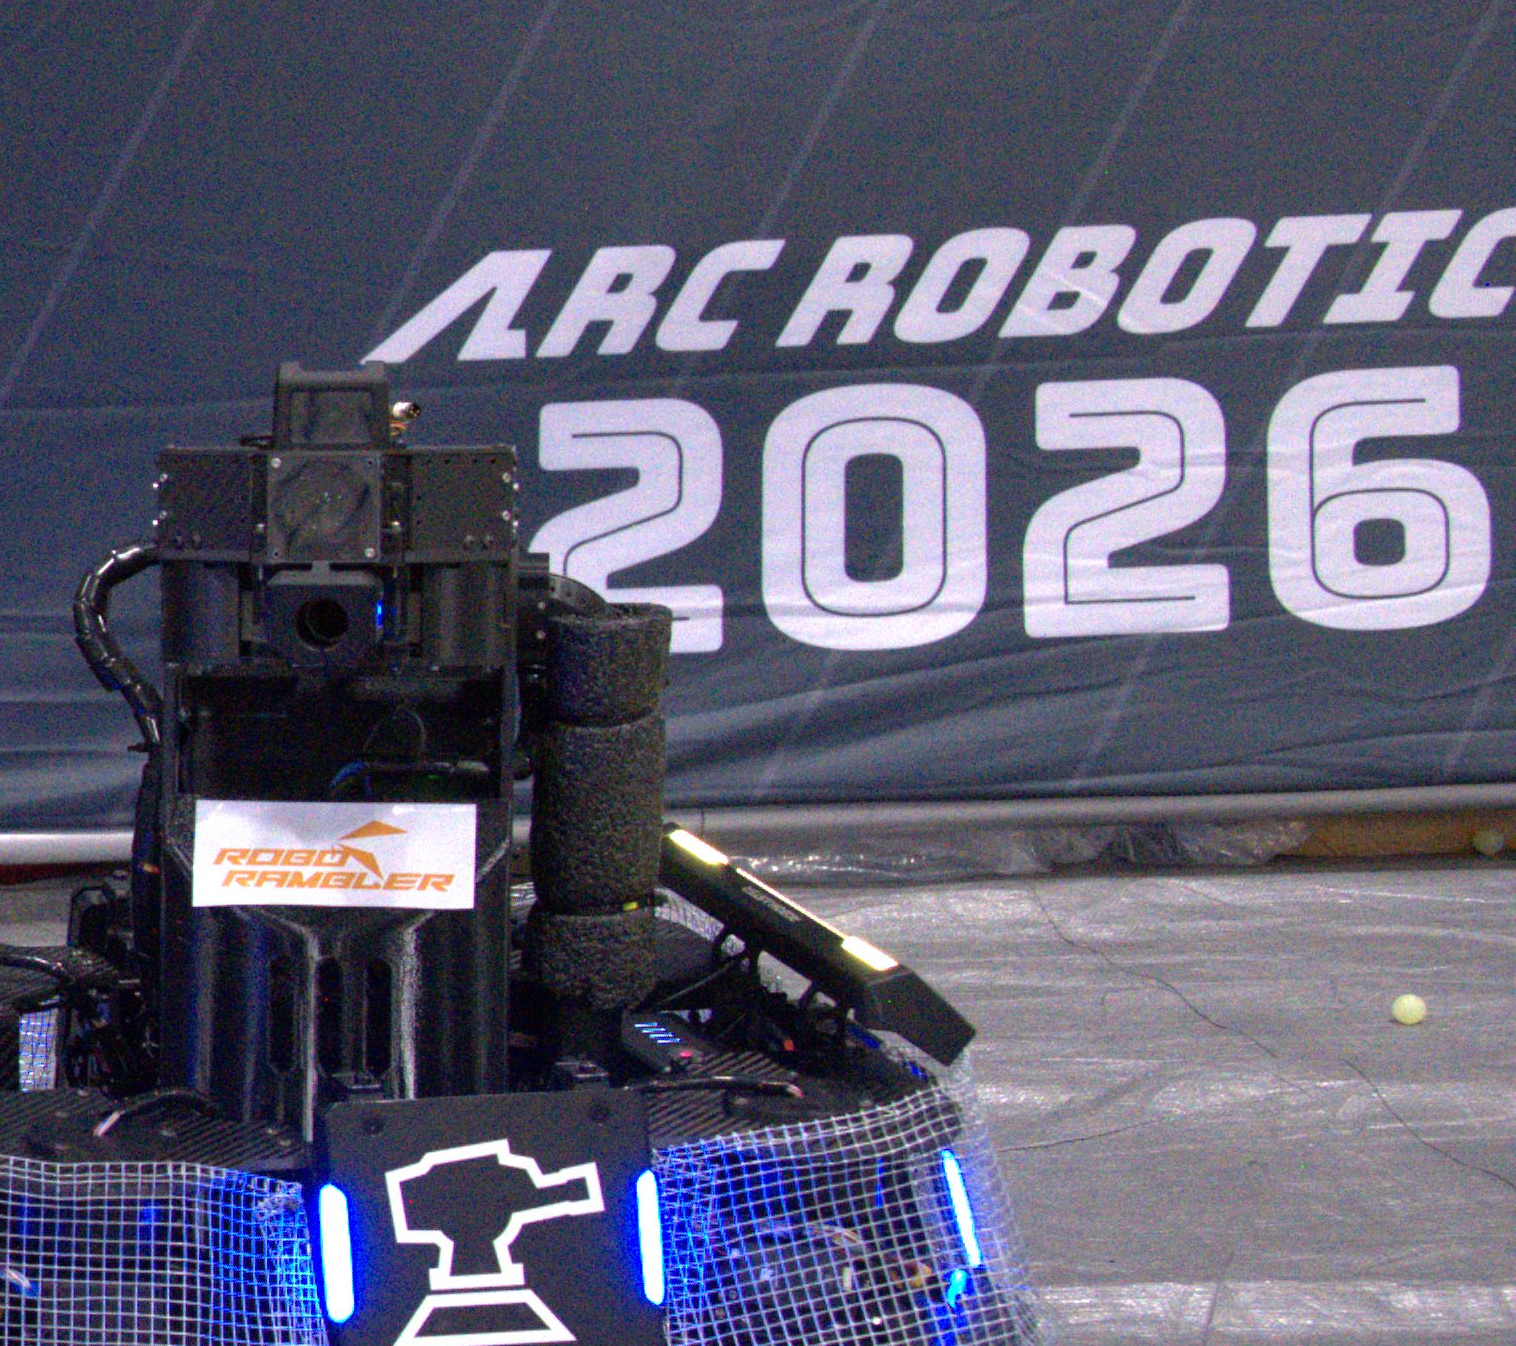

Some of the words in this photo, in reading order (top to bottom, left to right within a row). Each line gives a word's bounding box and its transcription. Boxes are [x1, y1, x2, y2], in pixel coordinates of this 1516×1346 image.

[361, 239, 785, 364] ARC
[775, 207, 1516, 348] ROBOTIC
[528, 365, 1491, 652] 2026
[213, 848, 353, 867] ROBO
[221, 870, 455, 892] RAMBLER
